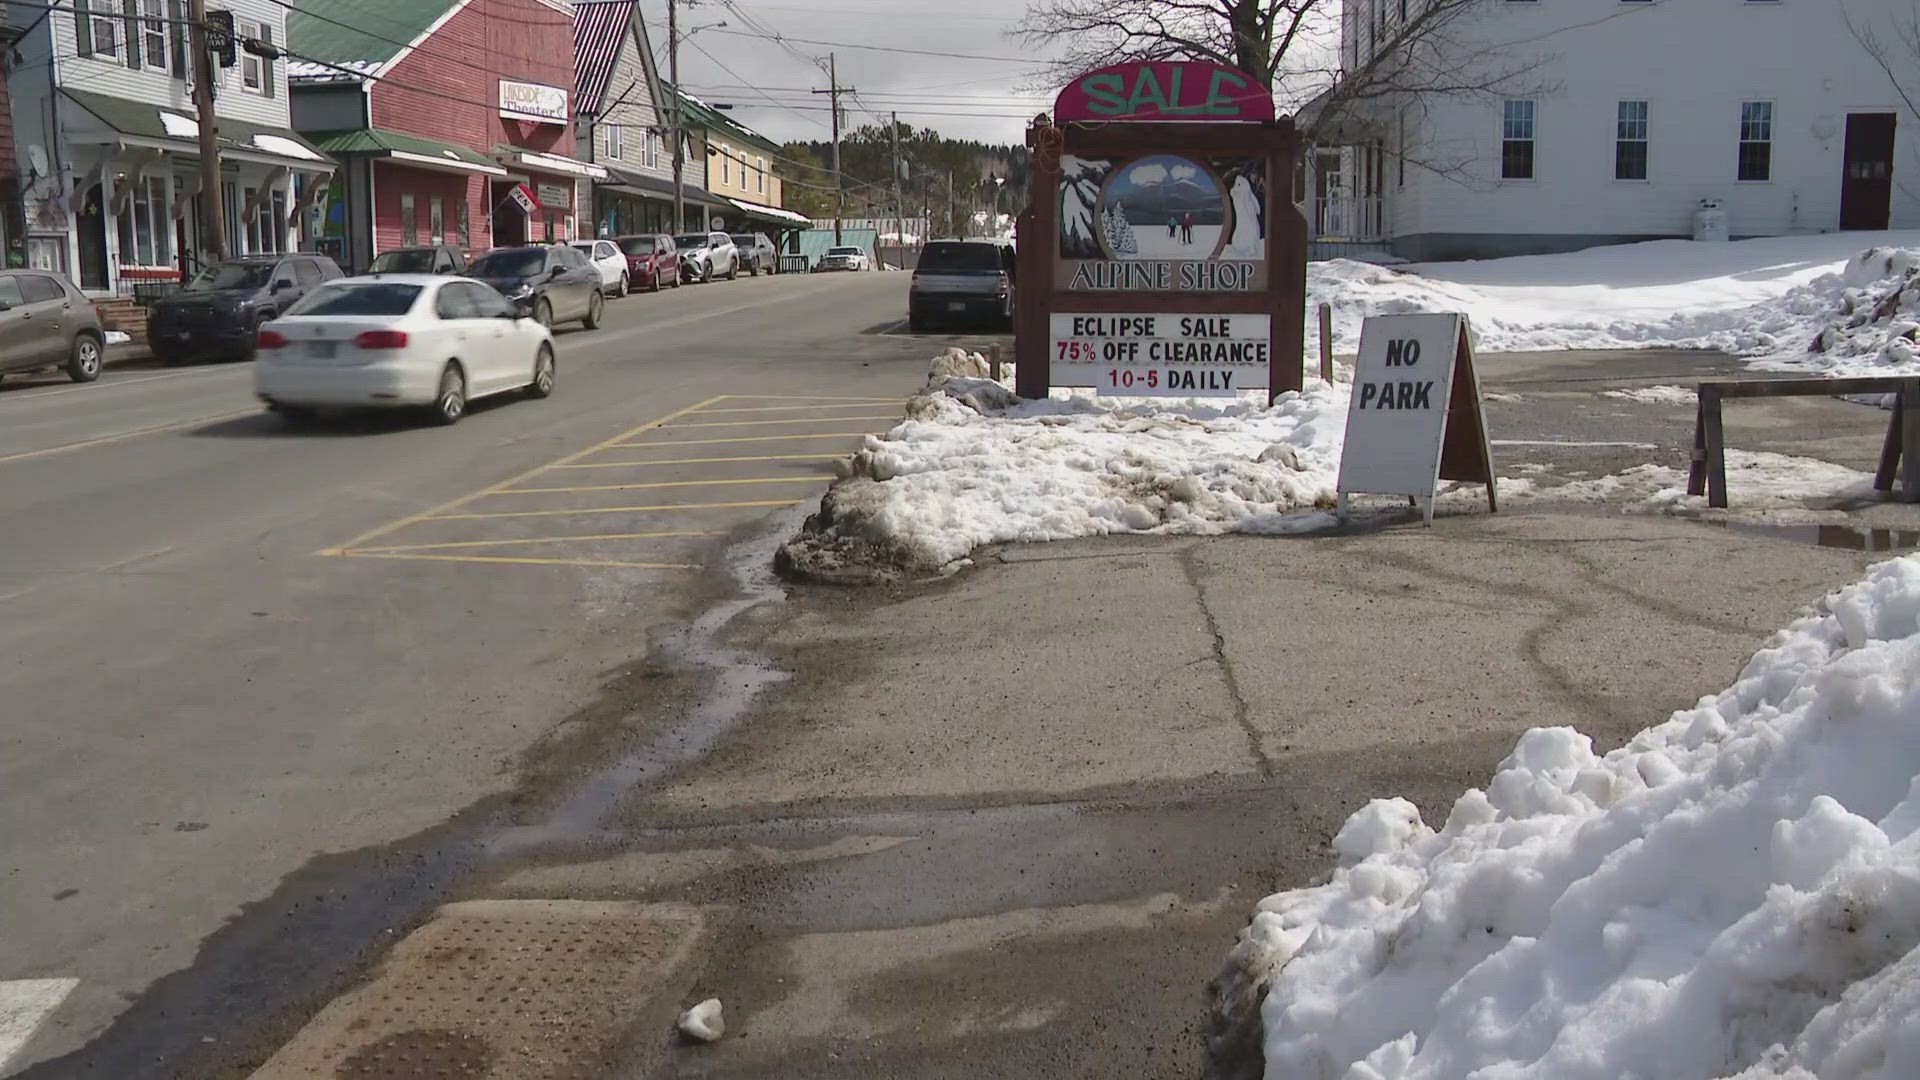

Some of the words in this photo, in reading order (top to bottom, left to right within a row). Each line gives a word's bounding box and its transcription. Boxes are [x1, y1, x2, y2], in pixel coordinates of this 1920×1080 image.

[1081, 66, 1247, 115] SALE
[503, 100, 556, 118] Theater
[1069, 261, 1171, 290] ALPINE
[1179, 261, 1255, 290] SHOP
[1073, 317, 1155, 336] ECLIPSE
[1180, 318, 1230, 337] SALE
[1057, 341, 1096, 361] 75%
[1103, 342, 1139, 361] OFF
[1149, 342, 1267, 362] CLEARANCE
[1385, 339, 1421, 367] NO
[1108, 369, 1158, 388] 10-5
[1168, 371, 1232, 389] DAILY
[1359, 381, 1434, 410] PARK
